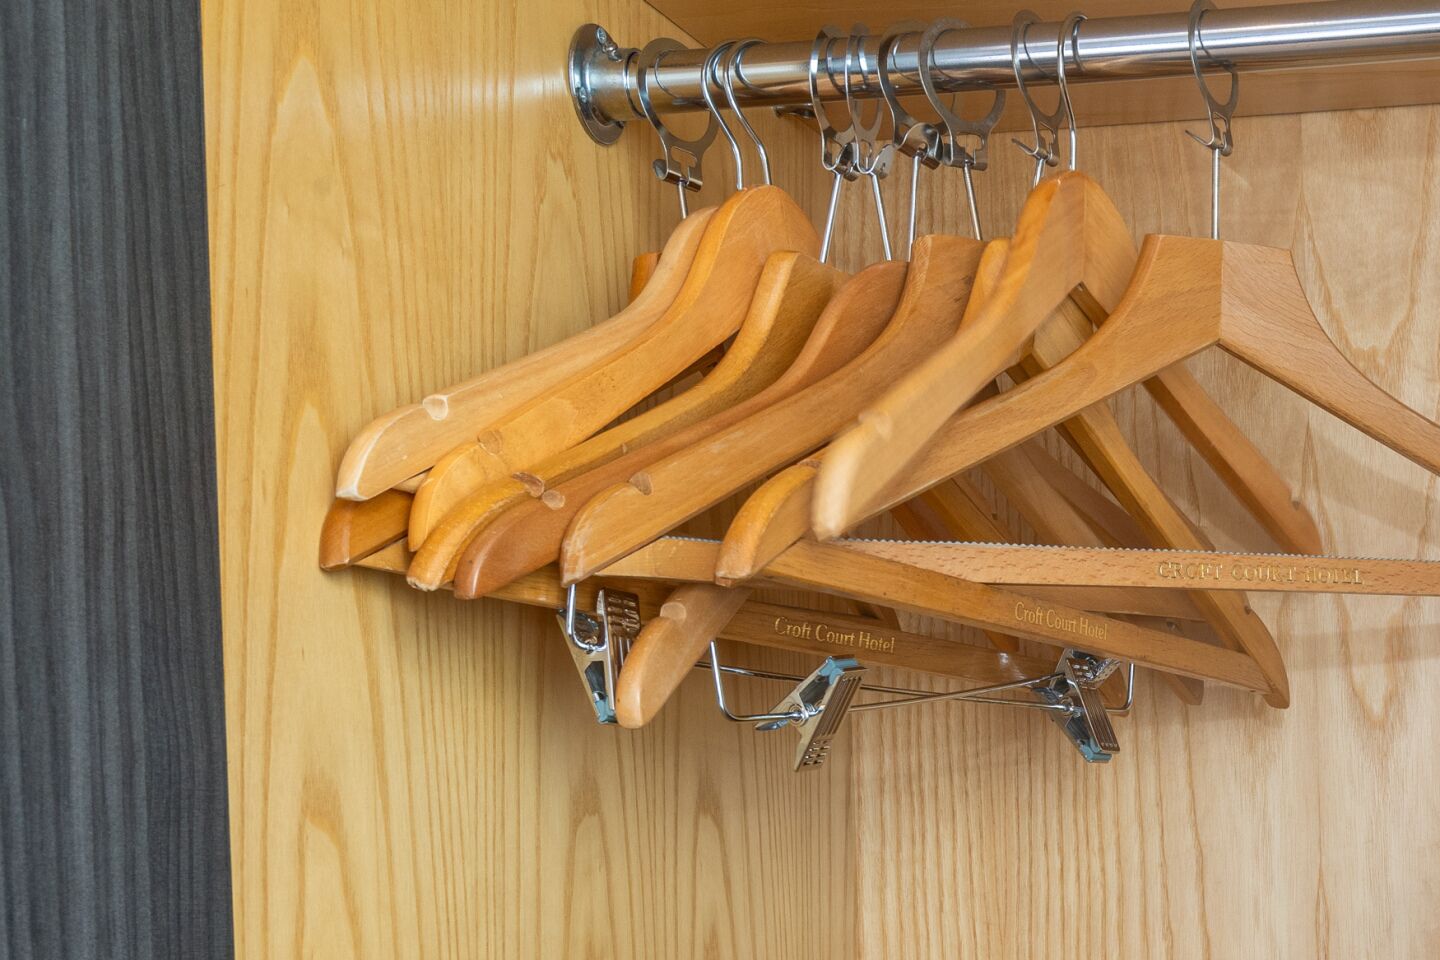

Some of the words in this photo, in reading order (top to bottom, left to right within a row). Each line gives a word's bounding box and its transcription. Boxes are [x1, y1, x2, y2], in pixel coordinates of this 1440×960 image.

[774, 616, 812, 639] Croft
[815, 624, 855, 646] Court
[858, 631, 895, 653] Hotel
[1015, 601, 1043, 624] Croft
[1046, 609, 1076, 632] Court
[1080, 617, 1107, 640] Hotel
